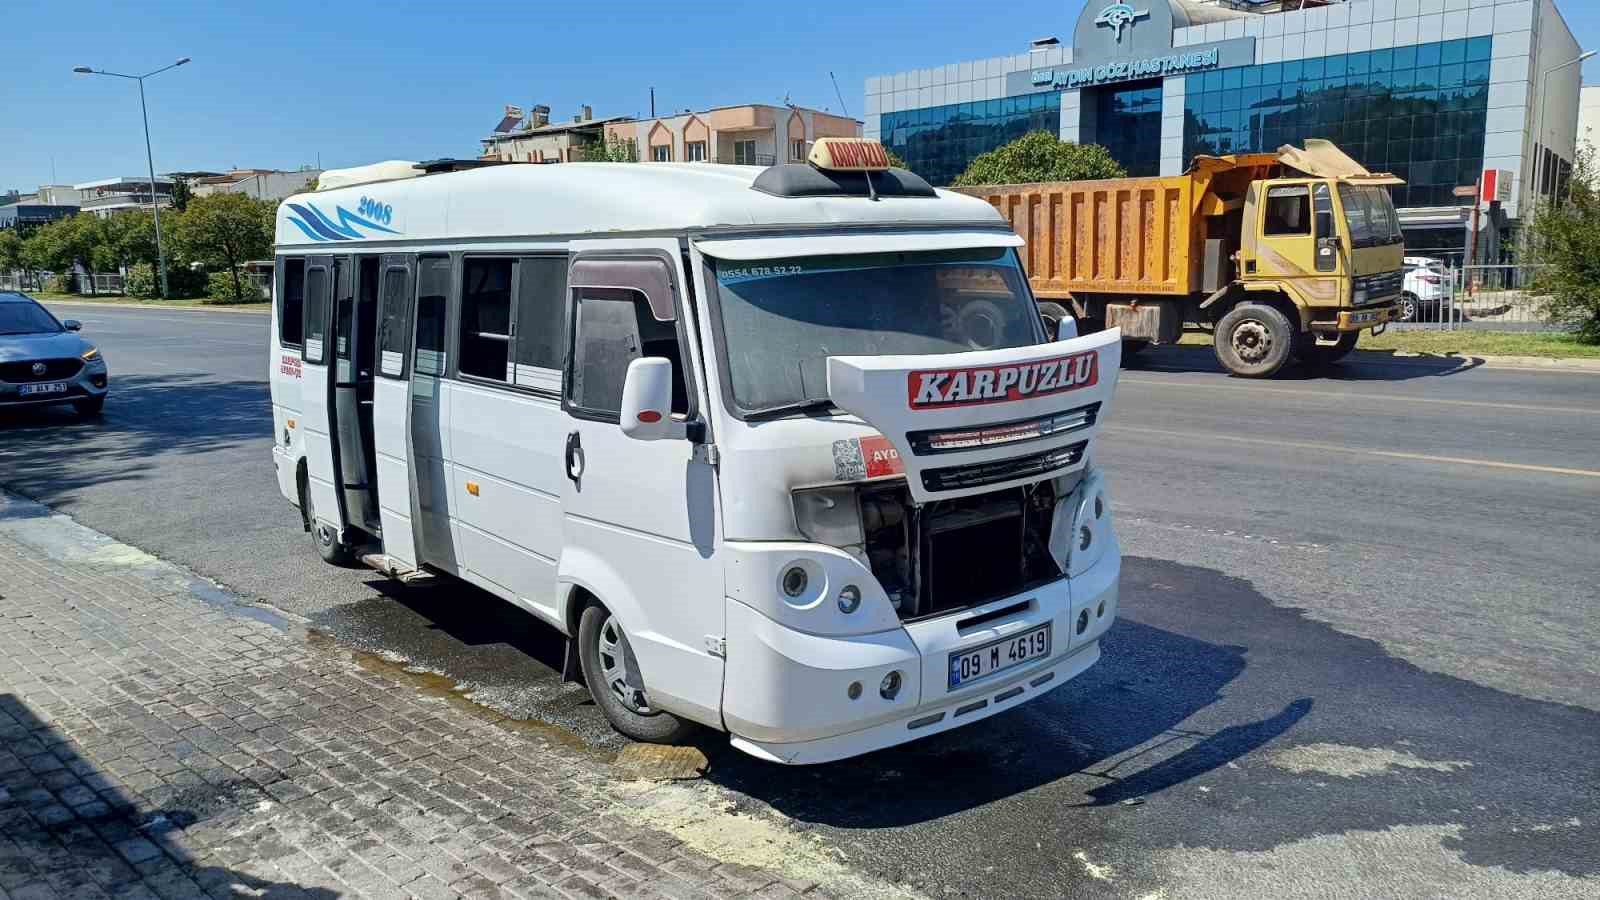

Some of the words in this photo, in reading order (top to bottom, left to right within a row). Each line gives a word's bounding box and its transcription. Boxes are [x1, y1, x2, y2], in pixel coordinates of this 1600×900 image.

[1053, 66, 1092, 88] AYDIN
[1094, 61, 1127, 82] GÖZ
[825, 142, 888, 167] KARPUZLU
[357, 195, 393, 226] 2008
[720, 266, 748, 279] 0554
[773, 265, 786, 275] 52
[789, 265, 802, 275] 22
[912, 354, 1094, 404] KARPUZLU
[961, 654, 980, 679] 09
[990, 646, 1000, 670] M
[1008, 631, 1045, 661] 4619
